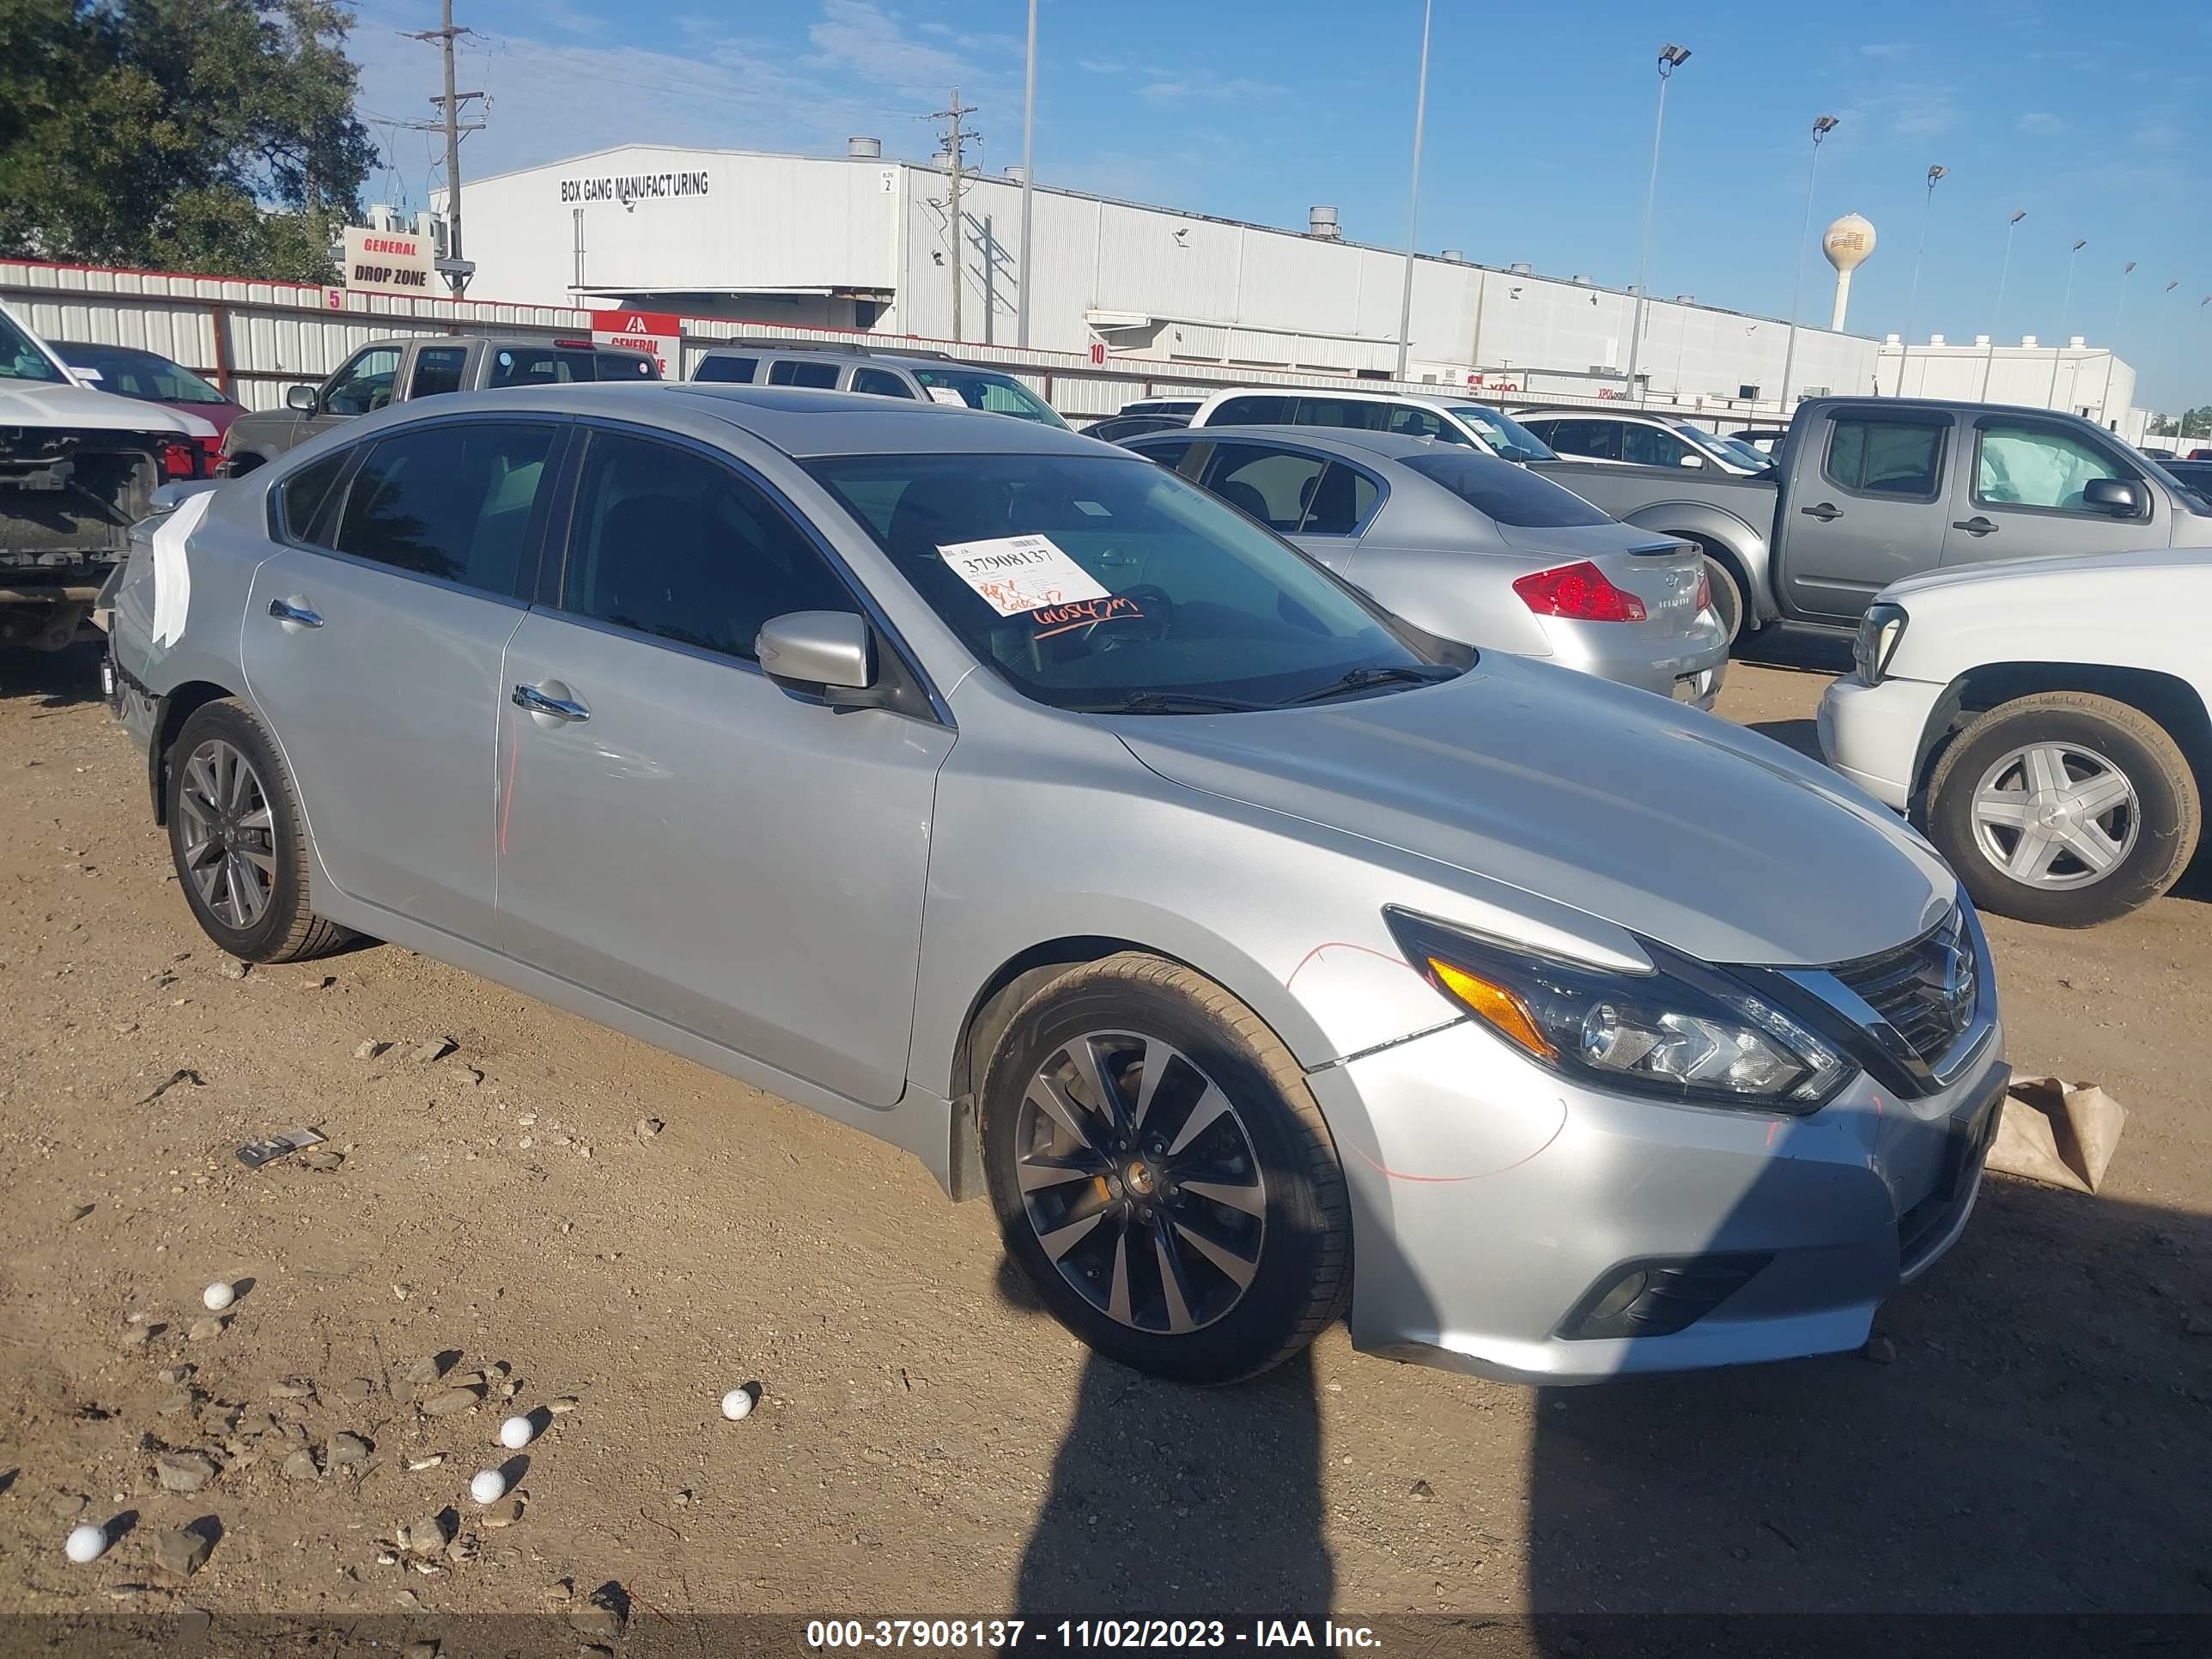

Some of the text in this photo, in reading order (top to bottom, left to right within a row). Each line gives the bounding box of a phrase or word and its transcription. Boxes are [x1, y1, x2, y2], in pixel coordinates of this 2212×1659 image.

[561, 171, 708, 203] BOX GANG MANUFACTURING
[885, 179, 890, 191] 2
[363, 238, 416, 256] GENERAL
[355, 264, 427, 287] DROP ZONE
[329, 290, 340, 308] 5
[1091, 343, 1104, 364] 10
[962, 550, 1053, 573] 37908137
